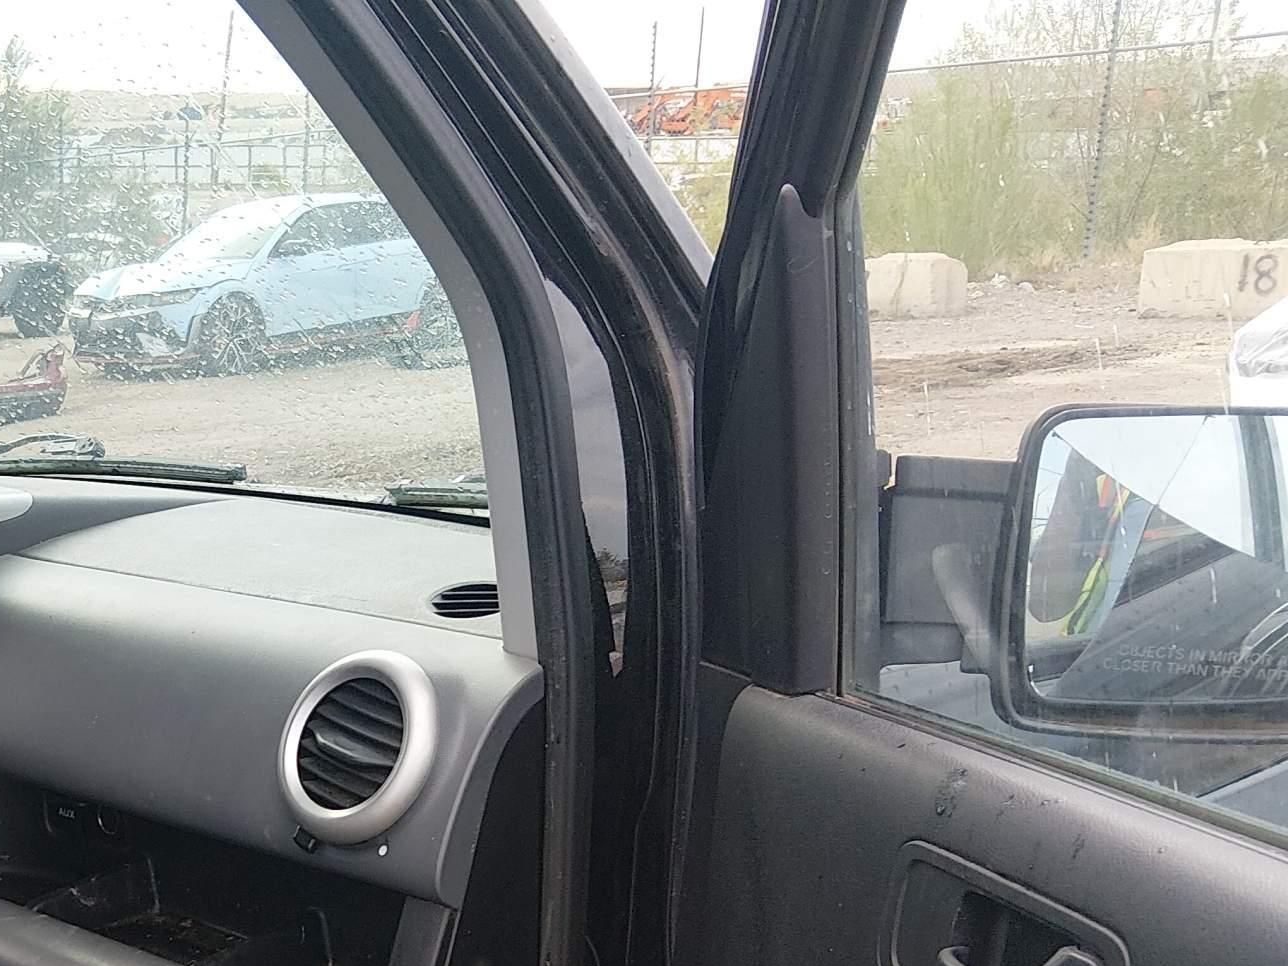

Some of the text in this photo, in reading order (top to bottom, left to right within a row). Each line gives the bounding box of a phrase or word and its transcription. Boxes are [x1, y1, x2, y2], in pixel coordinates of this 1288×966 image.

[1237, 253, 1279, 297] 18
[1119, 644, 1185, 660] OBJECTS
[1189, 648, 1205, 661] IN
[1103, 657, 1161, 673] CLOSER
[1167, 662, 1209, 677] THAN
[1212, 665, 1254, 680] THEY
